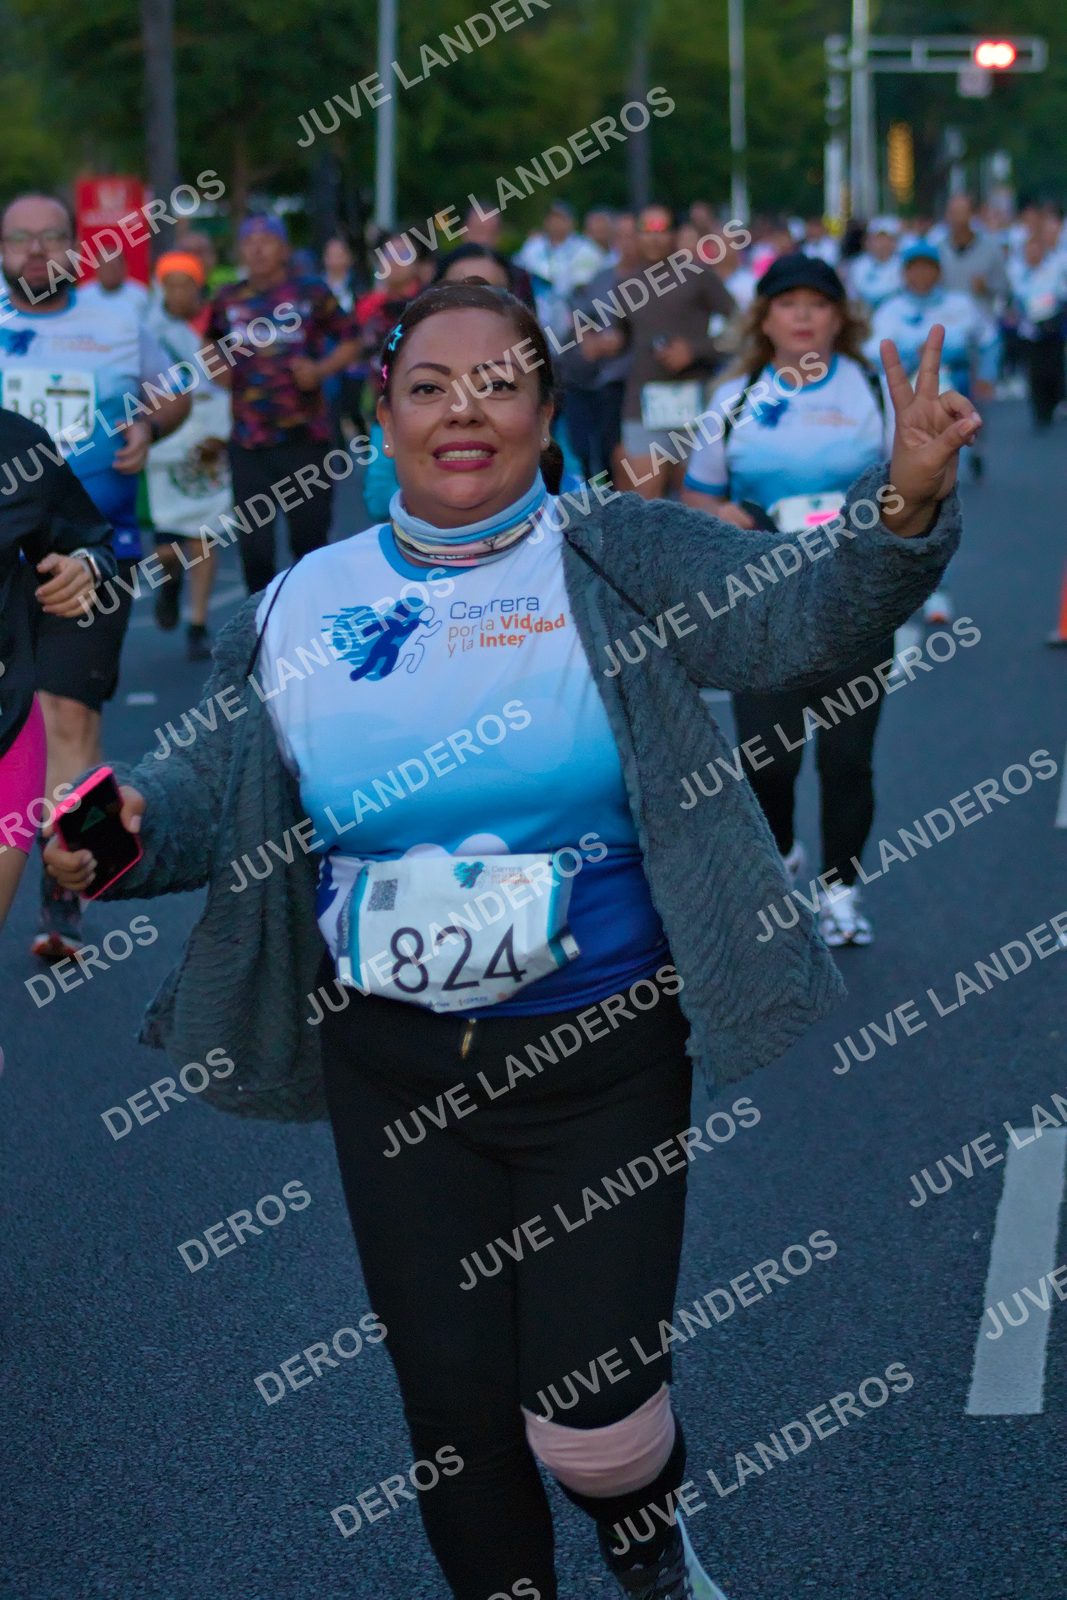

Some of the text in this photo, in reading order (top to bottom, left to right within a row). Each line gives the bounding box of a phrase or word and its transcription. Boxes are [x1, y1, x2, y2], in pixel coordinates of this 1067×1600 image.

[449, 596, 540, 620] Carrera
[448, 624, 478, 642] por
[390, 923, 527, 994] 824
